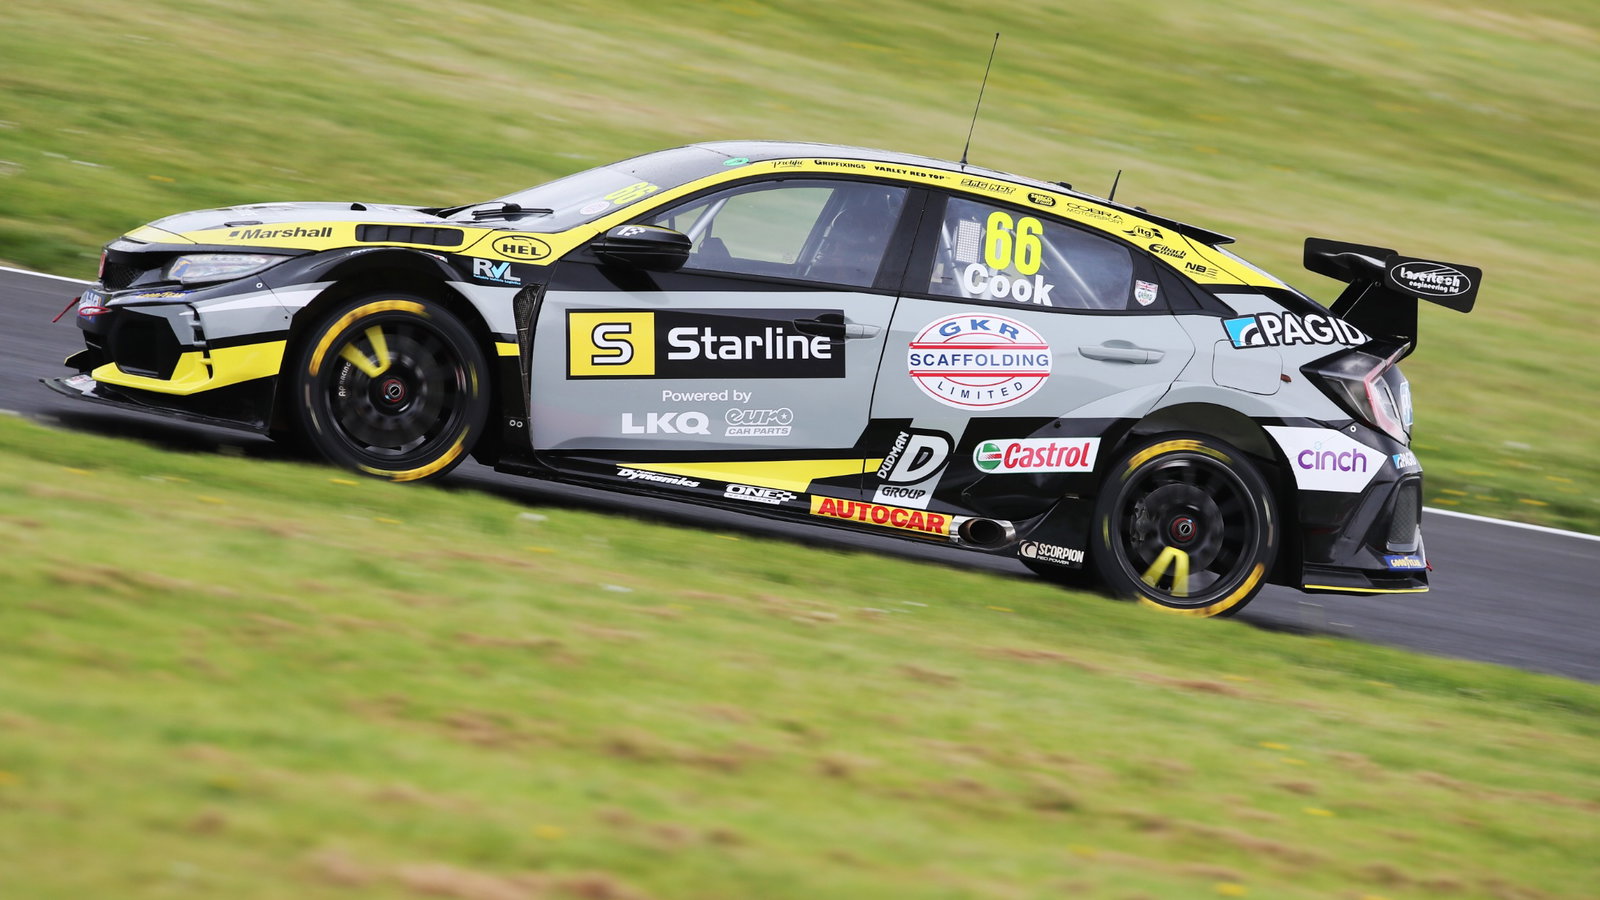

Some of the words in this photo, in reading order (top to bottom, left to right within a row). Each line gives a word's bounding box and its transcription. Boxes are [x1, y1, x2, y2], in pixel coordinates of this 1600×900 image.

[814, 159, 866, 169] GRIPFIXINGS
[874, 165, 907, 175] VARLEY
[909, 169, 927, 178] RED
[603, 181, 659, 205] 66
[1067, 202, 1123, 221] COBRA
[240, 226, 332, 241] Marshall
[1137, 227, 1152, 237] itg
[502, 243, 542, 257] HEL
[984, 211, 1044, 276] 66
[1148, 243, 1187, 257] Eibach
[473, 257, 521, 282] RVL
[963, 263, 1055, 307] Cook
[1408, 280, 1448, 293] engineering
[938, 319, 1020, 341] GKR
[1259, 314, 1366, 345] PAGID
[591, 322, 634, 366] S
[667, 326, 832, 361] Starline
[910, 353, 1049, 367] SCAFFOLDING
[662, 389, 728, 402] Powered
[733, 390, 752, 404] by
[937, 380, 1023, 400] LIMITED
[621, 411, 711, 435] LKQ
[725, 407, 794, 427] euro
[754, 427, 789, 436] PARTS
[876, 431, 910, 480] DUDMAN
[1003, 442, 1091, 469] Castrol
[1298, 449, 1367, 472] cinch
[617, 468, 700, 488] Dynamics
[726, 484, 776, 500] ONE
[881, 486, 926, 500] GROUP
[818, 498, 945, 534] AUTOCAR
[1038, 543, 1084, 563] SCORPION
